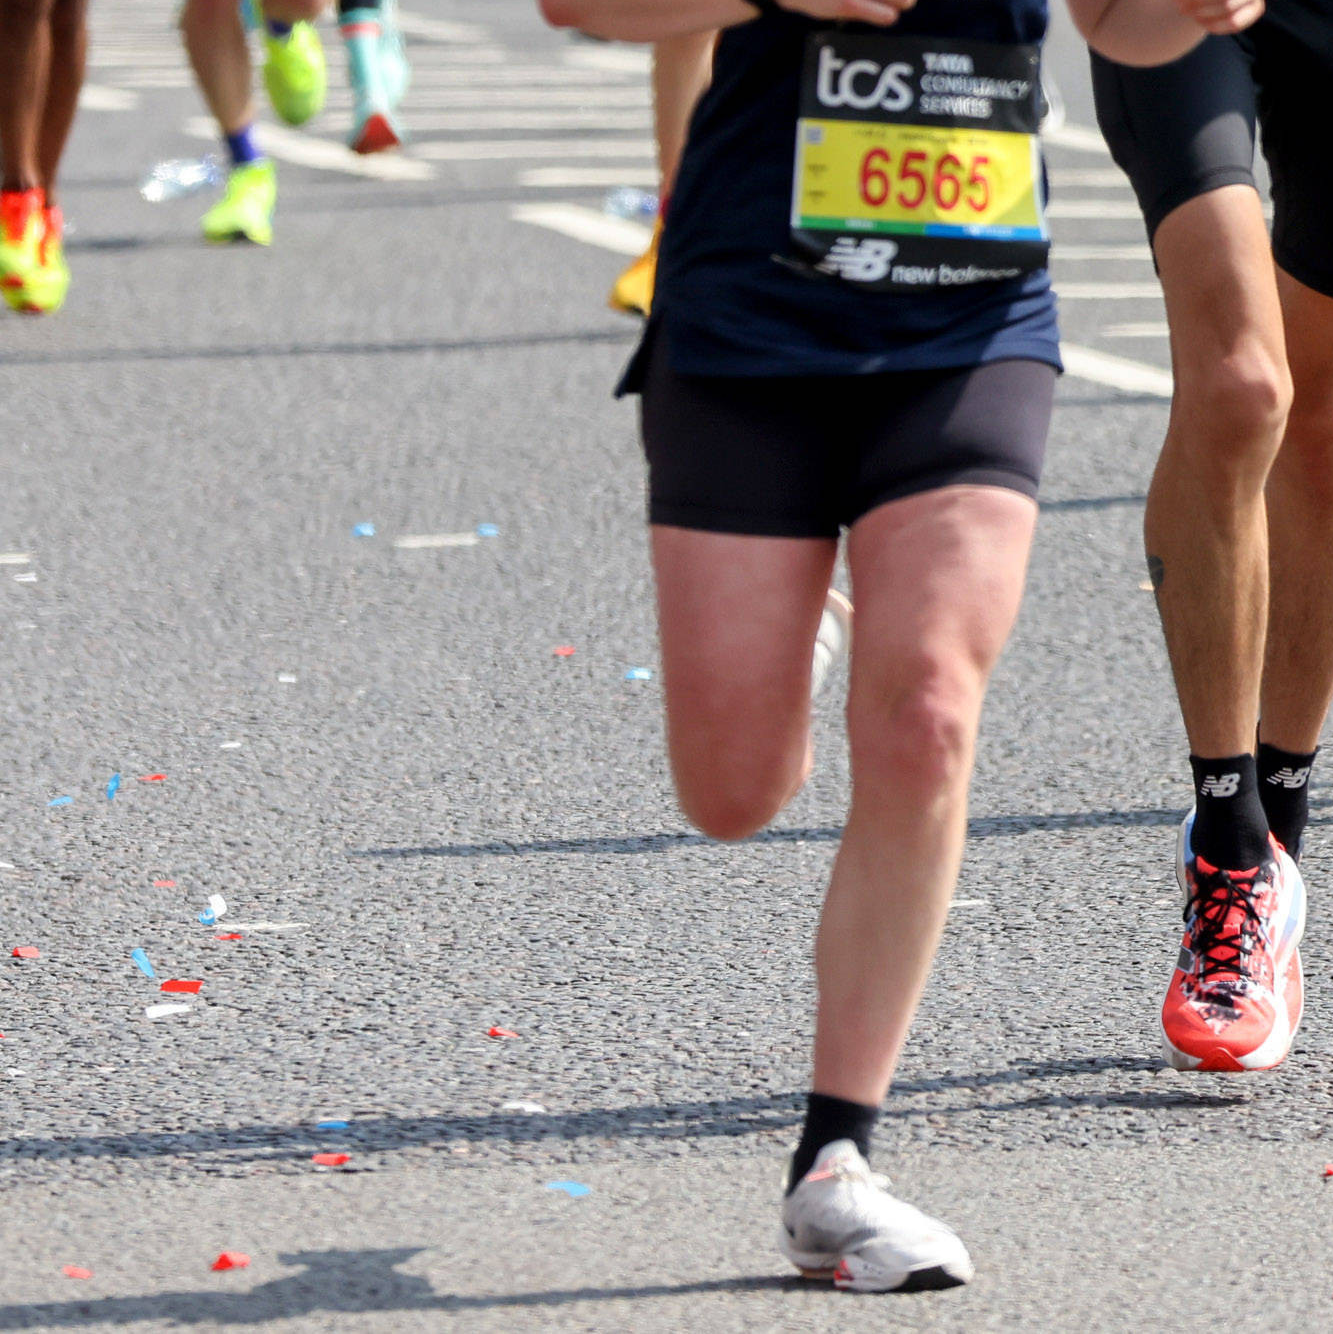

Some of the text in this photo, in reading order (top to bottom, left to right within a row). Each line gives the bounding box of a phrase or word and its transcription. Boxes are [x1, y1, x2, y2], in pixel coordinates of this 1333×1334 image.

[817, 45, 914, 112] tcs
[919, 71, 1031, 100] CONSULTANCY
[919, 94, 993, 119] SERVICES
[860, 146, 991, 212] 6565
[891, 265, 936, 285] new
